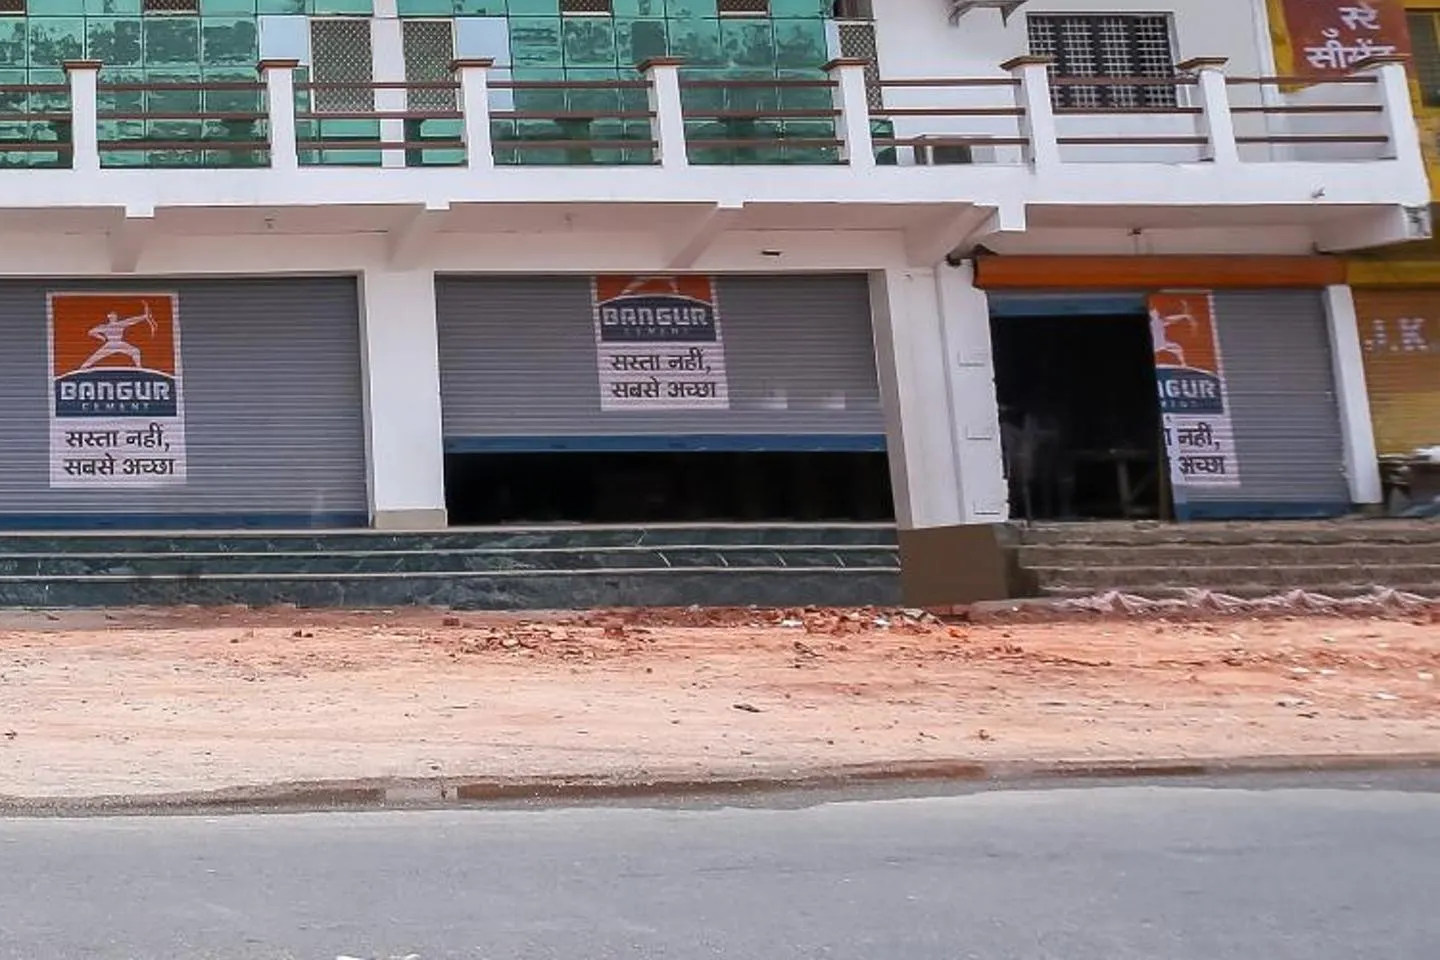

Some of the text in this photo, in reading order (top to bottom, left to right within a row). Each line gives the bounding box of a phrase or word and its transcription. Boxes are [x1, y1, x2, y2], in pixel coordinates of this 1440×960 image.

[602, 308, 709, 326] BANGUR
[610, 354, 660, 371] सस्ता
[60, 381, 170, 400] BANGUR
[611, 376, 716, 398] सबसे अच्छा
[65, 430, 119, 447] सस्ता
[63, 453, 176, 475] सबसे अच्छा
[1179, 456, 1225, 475] अच्छा
